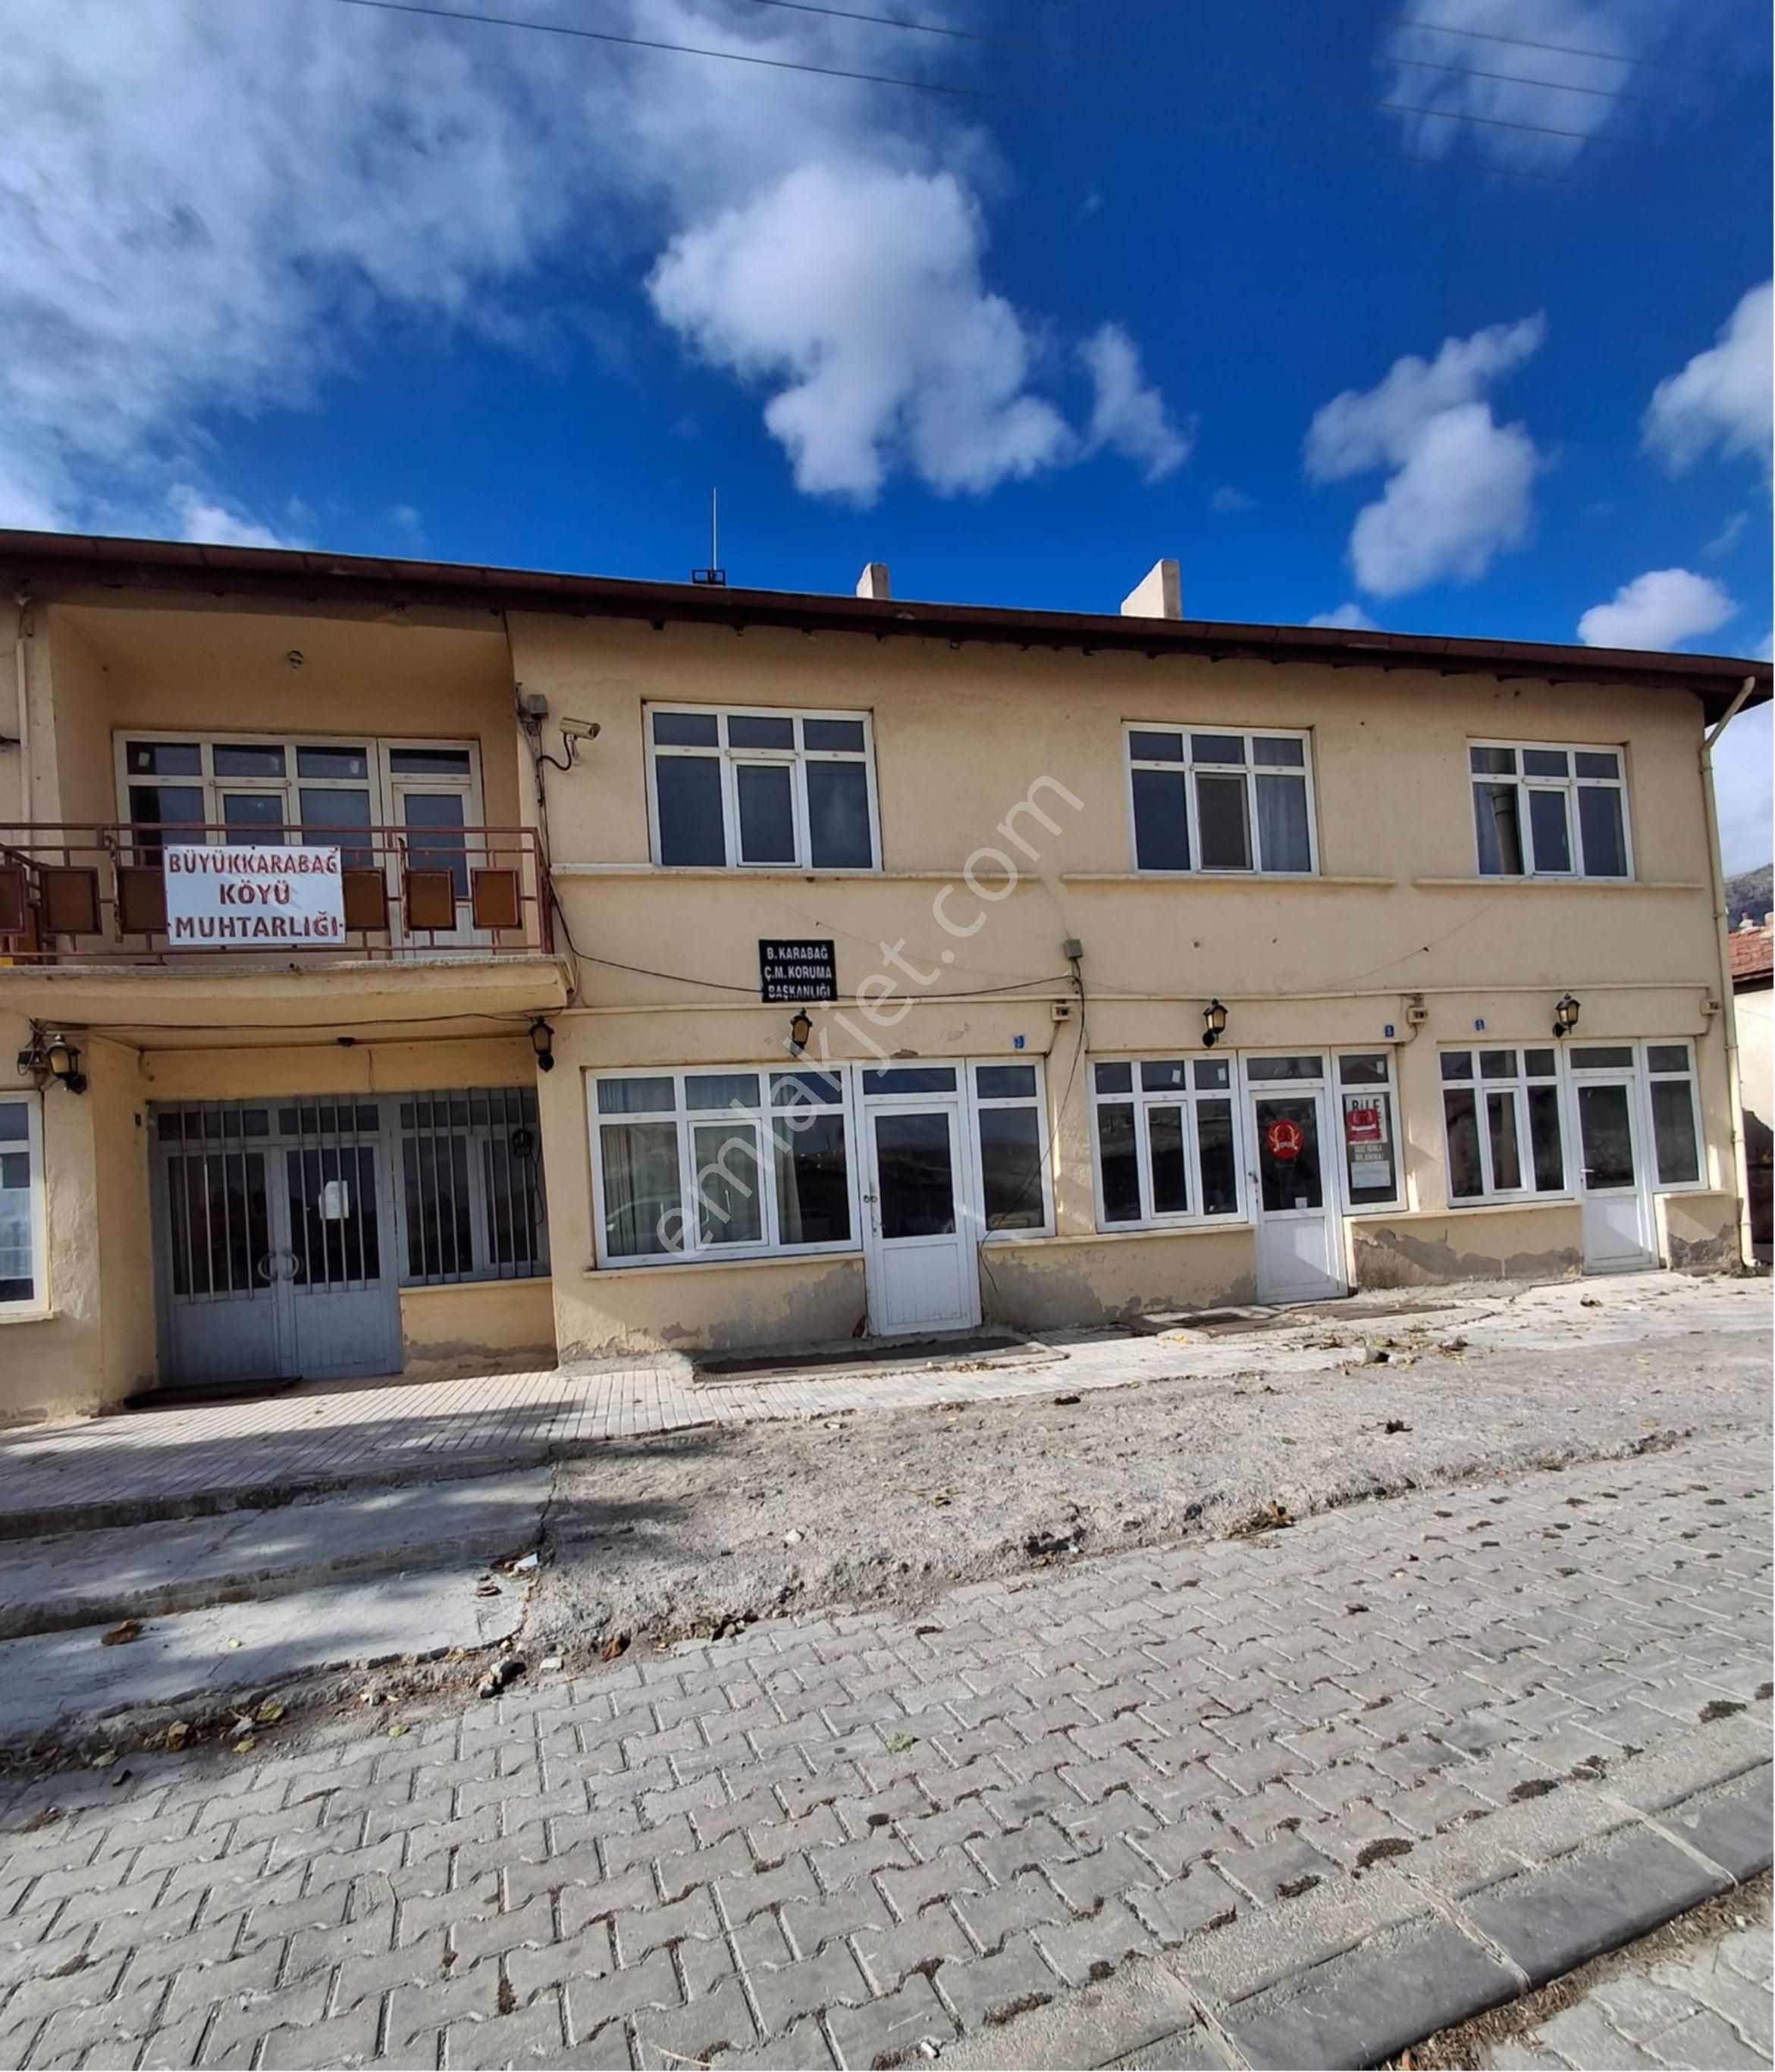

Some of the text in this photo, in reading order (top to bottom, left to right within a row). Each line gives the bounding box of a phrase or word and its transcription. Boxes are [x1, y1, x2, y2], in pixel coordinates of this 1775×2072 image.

[169, 849, 337, 874] BÜYÜKKARABAĞ
[219, 879, 290, 904] KÖYÜ
[174, 911, 338, 938] MUHTARLIĞI
[767, 945, 828, 960] B. KARABAĞ
[764, 965, 833, 982] Ç.M. KORUMA
[768, 983, 831, 1000] BAŞKANLIĞI
